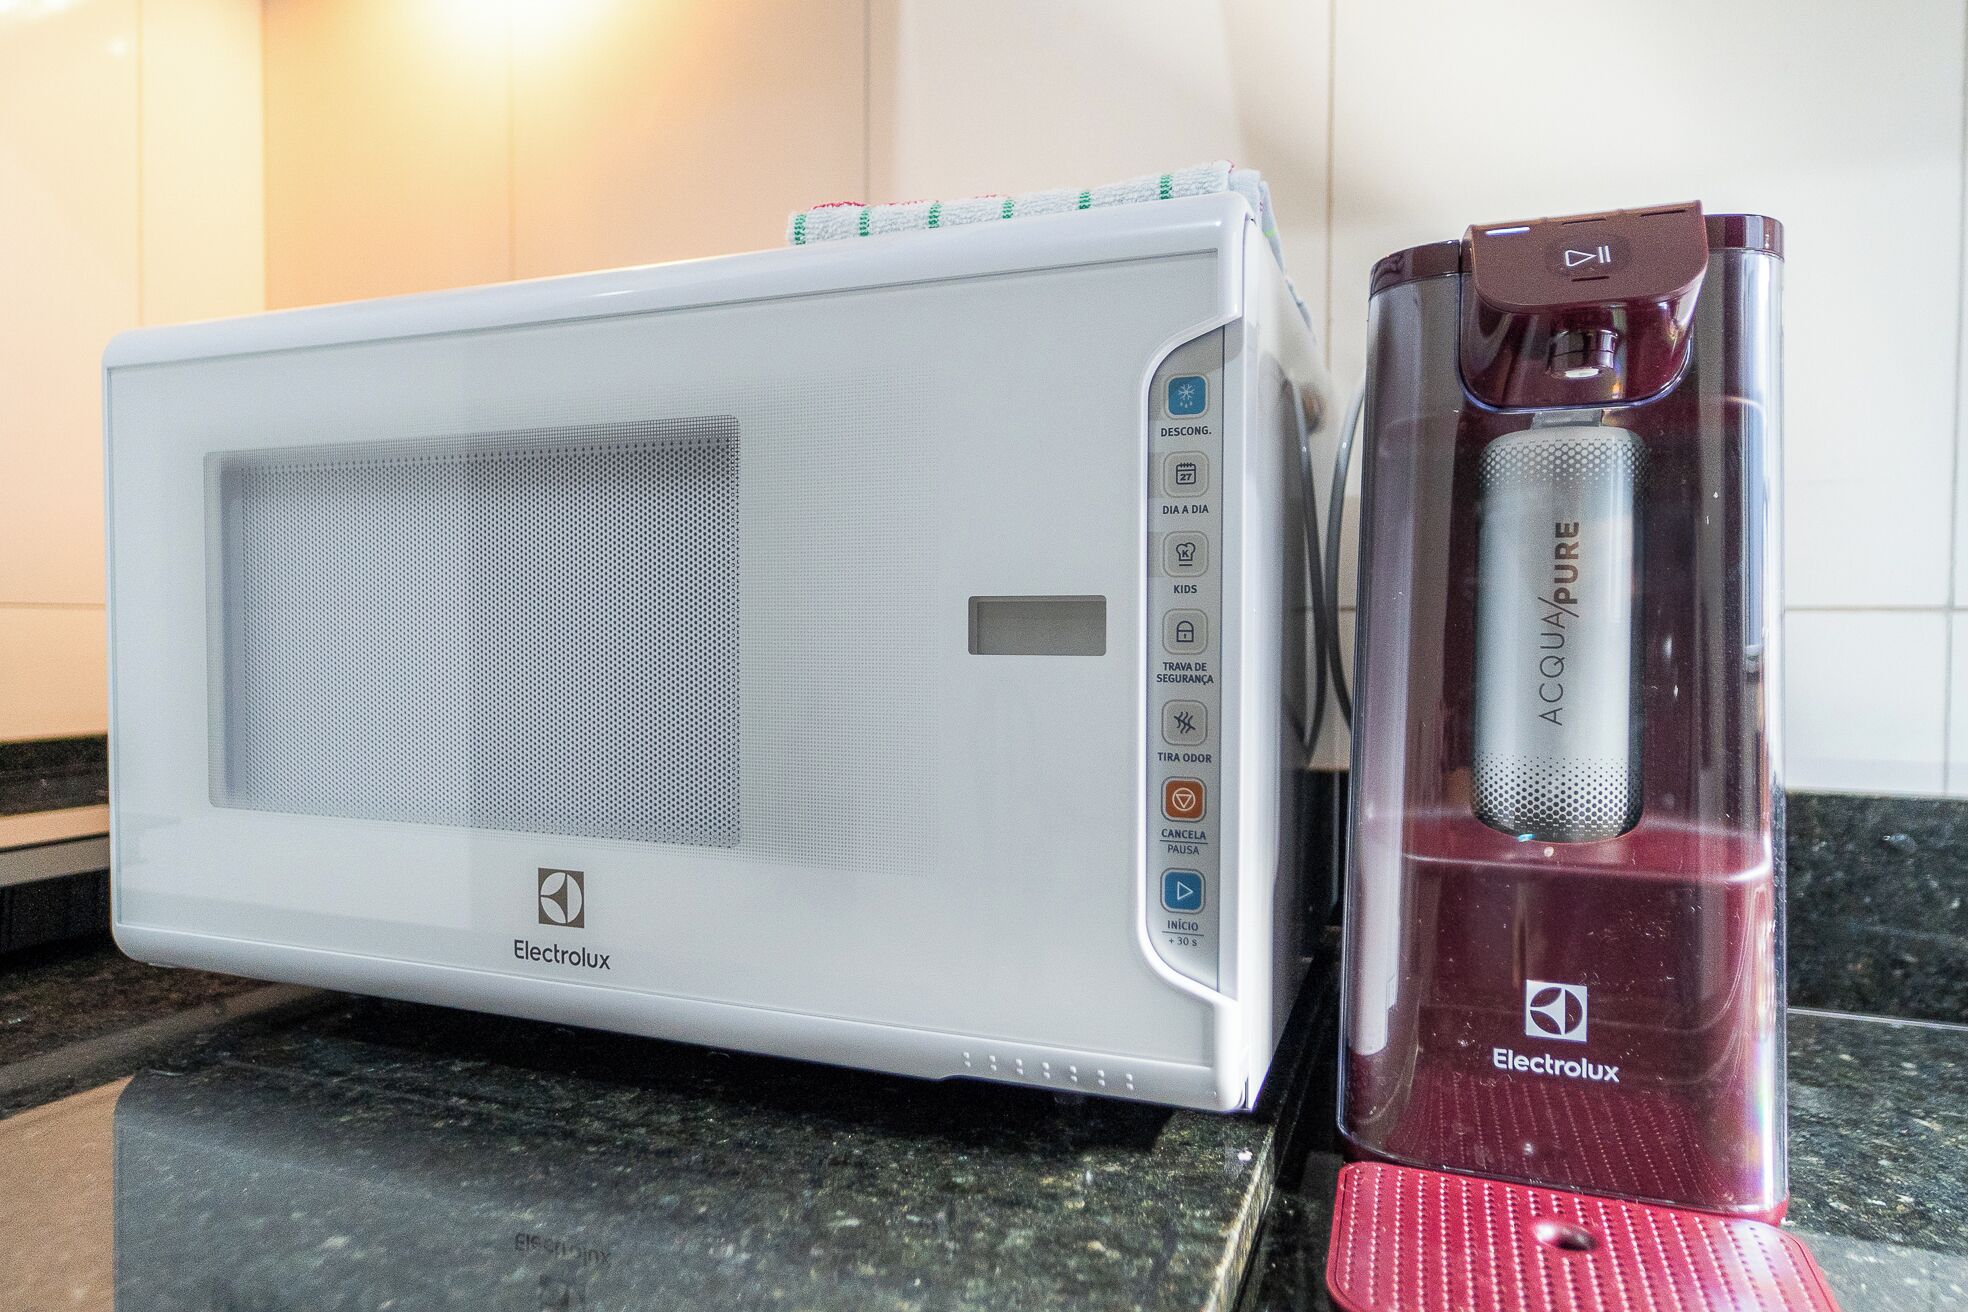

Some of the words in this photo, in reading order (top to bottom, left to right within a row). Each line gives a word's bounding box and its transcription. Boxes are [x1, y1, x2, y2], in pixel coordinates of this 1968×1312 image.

[1161, 426, 1212, 437] DESCONG.
[1180, 473, 1193, 481] 27
[1162, 505, 1180, 515] DIA
[1181, 505, 1190, 515] A
[1191, 504, 1209, 514] DIA
[1182, 550, 1190, 558] K
[1174, 584, 1198, 594] KIDS
[1163, 662, 1193, 672] TRAVA
[1194, 663, 1207, 672] DE
[1156, 673, 1214, 685] SEGURANÇA
[1157, 752, 1181, 762] TIRA
[1183, 753, 1212, 763] ODOR
[1161, 829, 1206, 840] CANCELA
[1167, 844, 1200, 855] PAUSA
[1167, 919, 1199, 931] INÍCIO
[1177, 936, 1190, 946] 30
[1191, 939, 1198, 947] s
[514, 939, 611, 969] Electrolux
[1493, 1048, 1620, 1082] Electrolux
